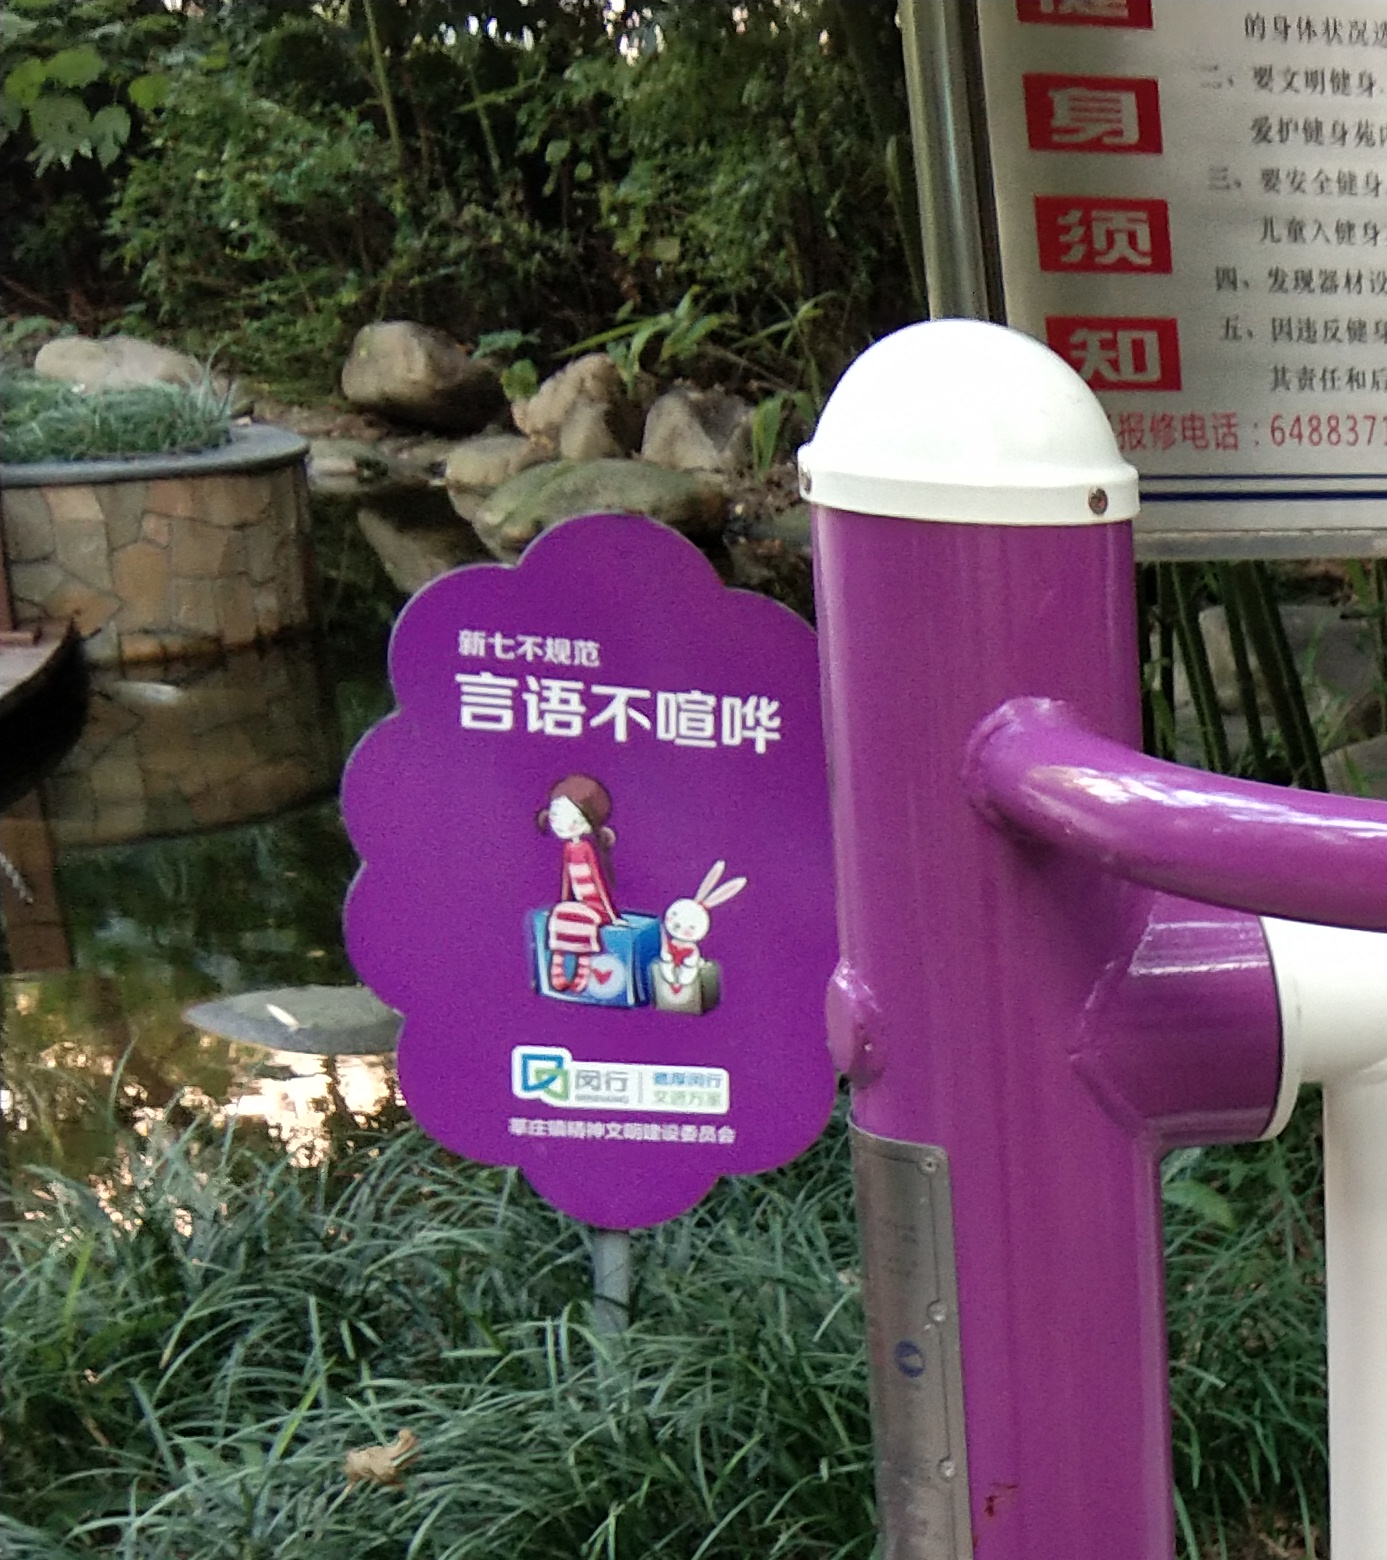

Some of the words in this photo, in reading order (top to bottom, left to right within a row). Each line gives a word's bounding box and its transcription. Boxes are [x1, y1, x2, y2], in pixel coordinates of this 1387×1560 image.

[457, 629, 601, 668] 新七不规范
[454, 671, 782, 754] 言语不喧哗
[574, 1069, 628, 1093] 闵行
